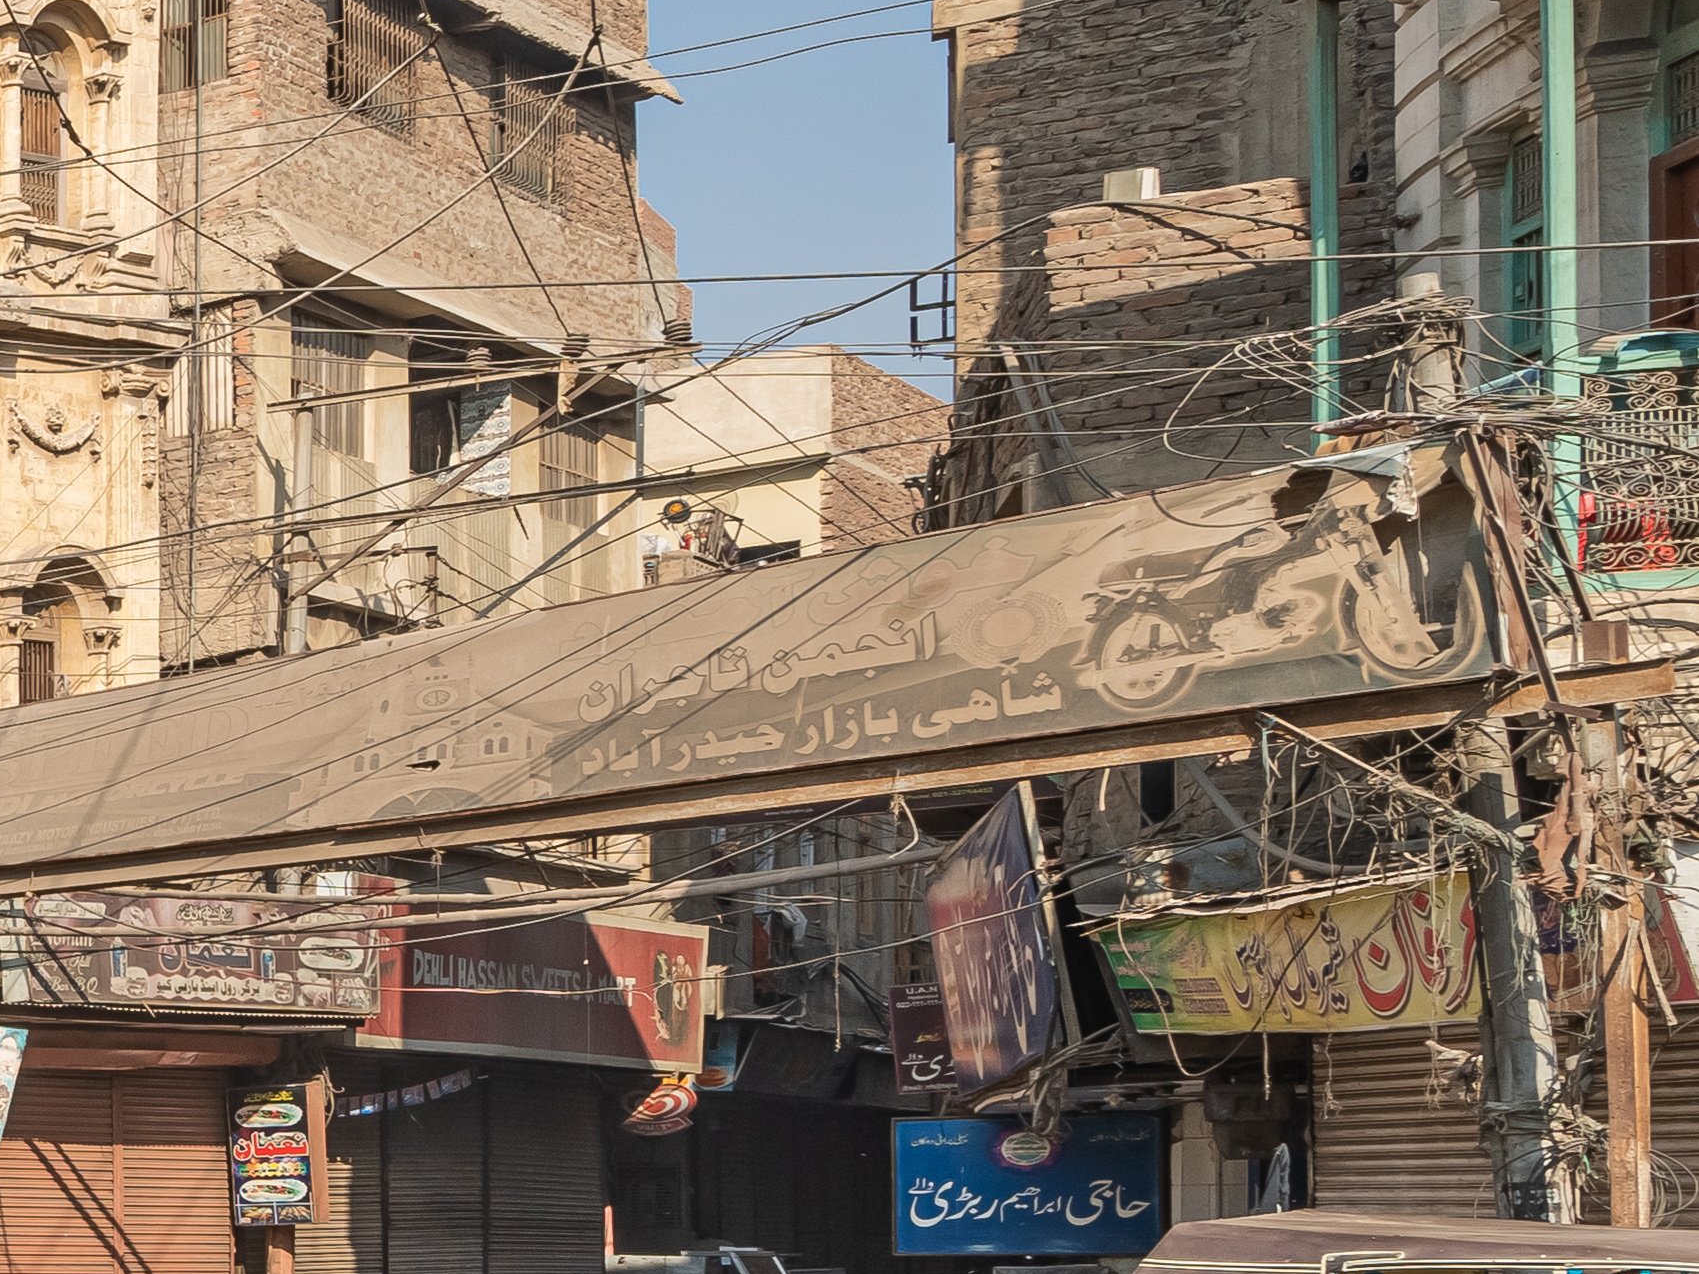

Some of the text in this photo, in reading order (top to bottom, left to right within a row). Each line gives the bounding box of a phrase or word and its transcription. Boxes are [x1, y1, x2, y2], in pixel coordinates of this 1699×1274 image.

[794, 701, 897, 755] بازار
[413, 949, 453, 986] DEHLI
[458, 958, 516, 991] HASSAN
[522, 964, 580, 1001] SWEETS
[233, 1131, 309, 1161] نعمان
[1066, 1179, 1151, 1225] حاجی
